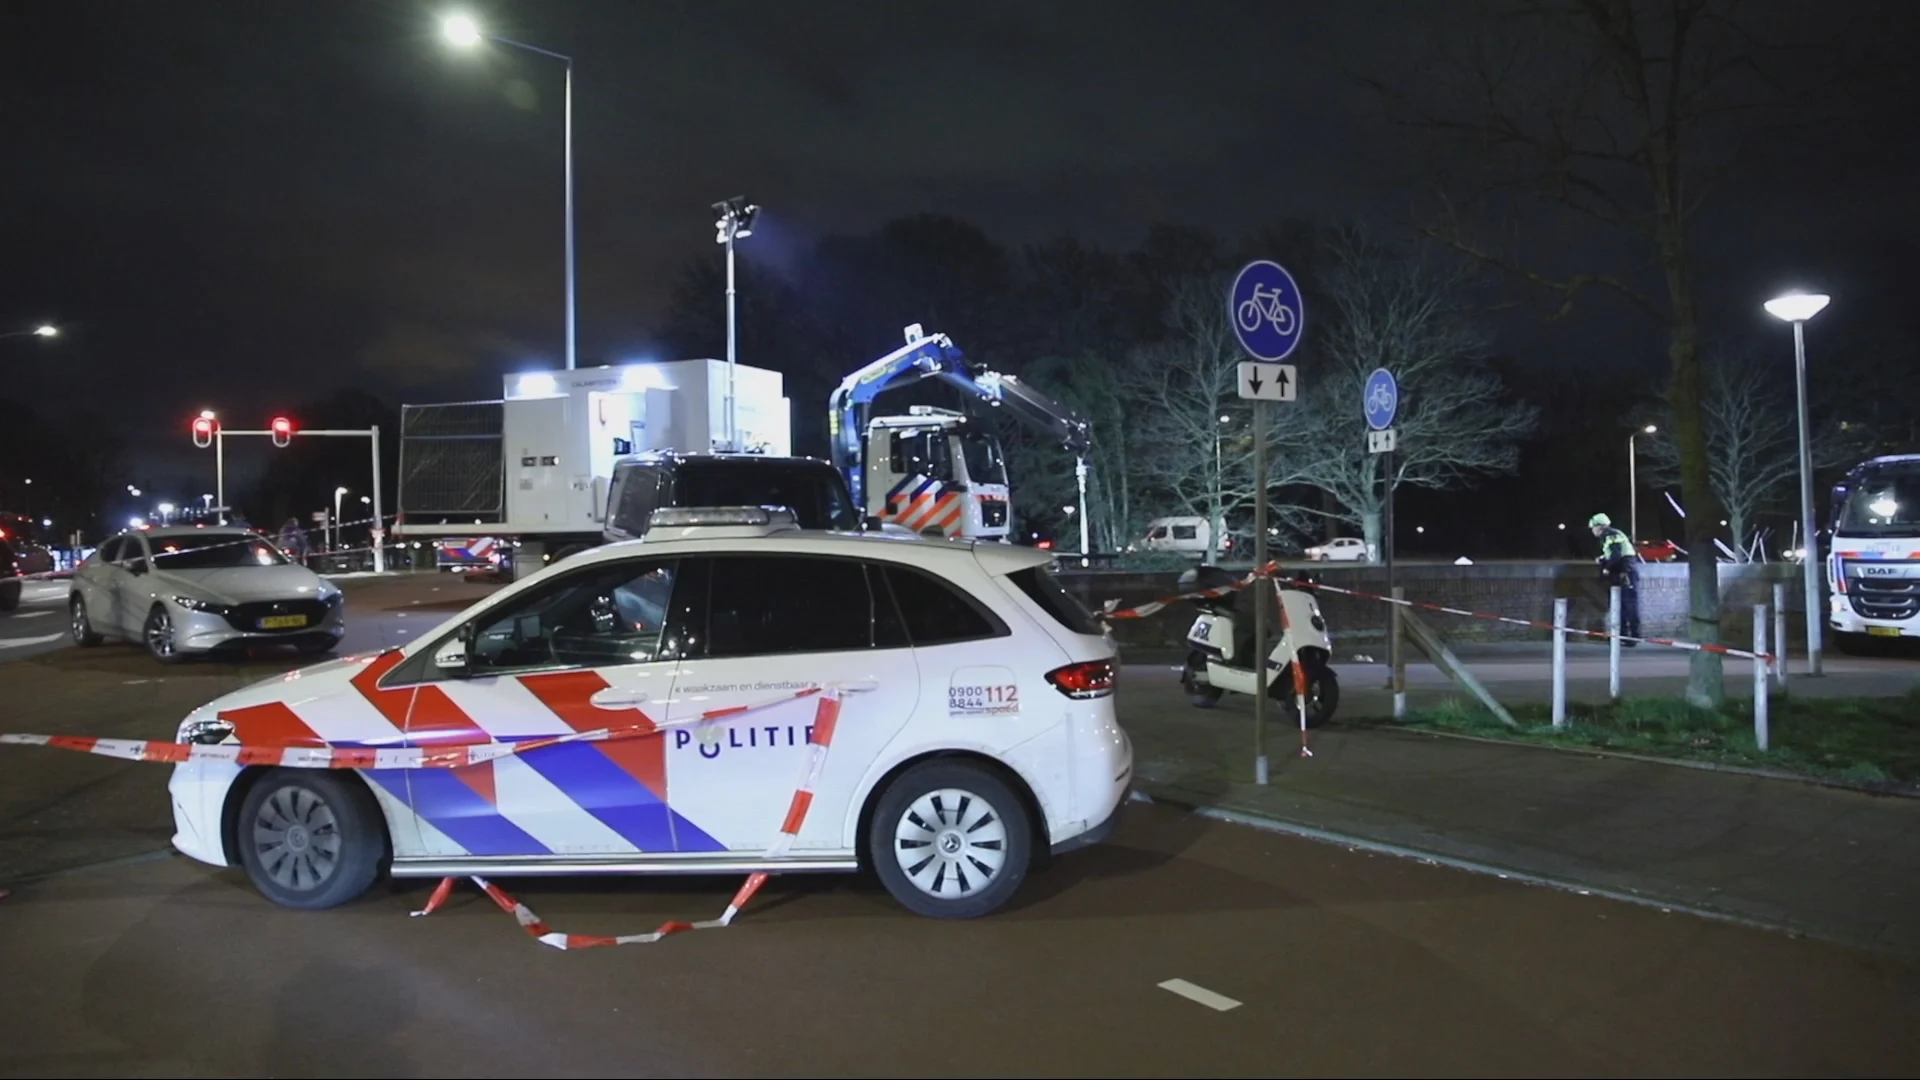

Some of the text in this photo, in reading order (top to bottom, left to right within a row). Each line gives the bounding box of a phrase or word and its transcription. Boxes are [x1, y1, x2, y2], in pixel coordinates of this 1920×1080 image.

[740, 683, 752, 691] en
[949, 686, 983, 697] 0900
[985, 684, 1018, 702] 112
[949, 698, 983, 708] 8844
